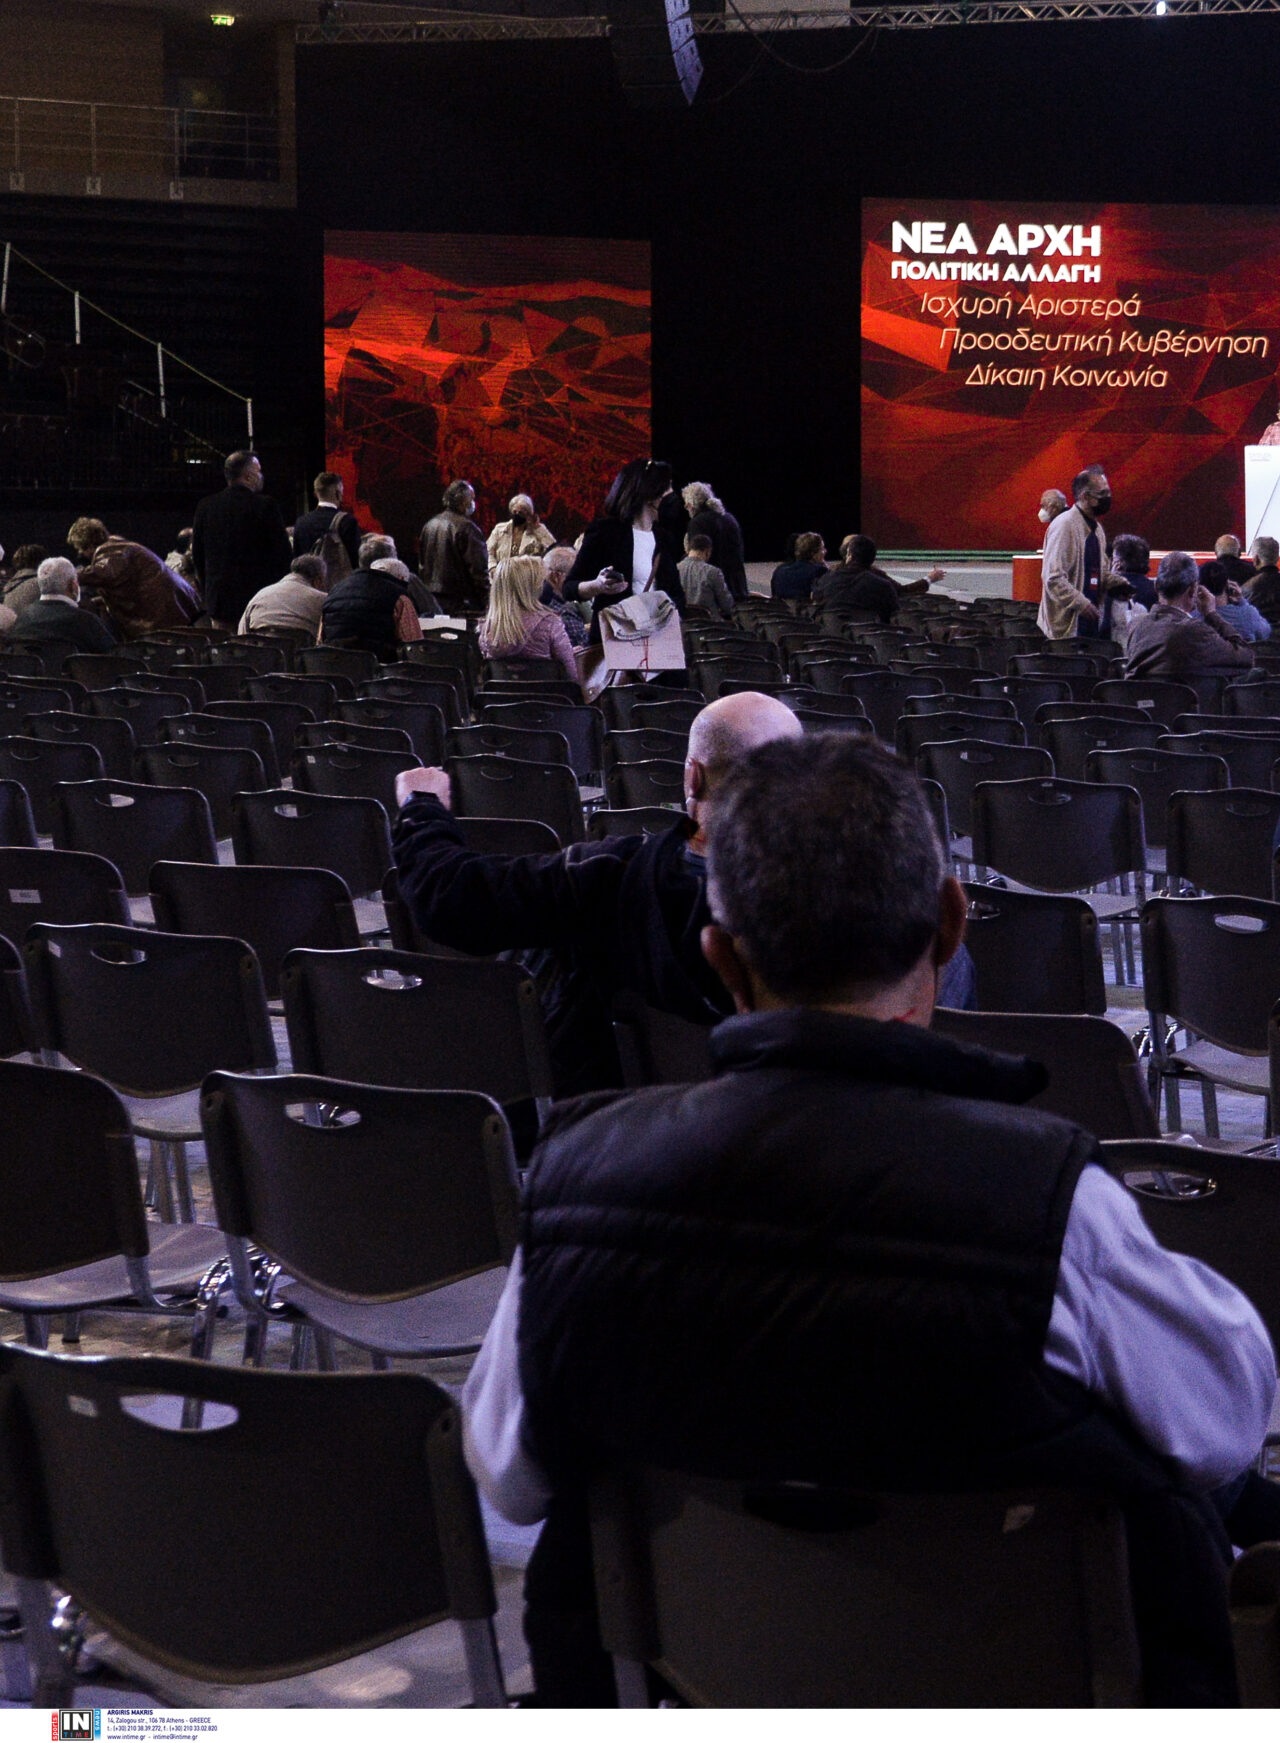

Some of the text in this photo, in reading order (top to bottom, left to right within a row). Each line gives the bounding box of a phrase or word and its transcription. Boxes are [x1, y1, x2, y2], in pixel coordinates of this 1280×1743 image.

[891, 221, 1101, 257] ΝΕΑ ΑΡΧΗ
[891, 261, 1101, 283] ΠΟΛΙΤΙΚΗ ΑΛΛΑΓΗ
[920, 291, 1141, 319] Ισχυρή Αριστερά
[939, 328, 1268, 358] Προοδευτική Κυβέρνηση
[965, 361, 1168, 391] Δίκαιη Κοινωνία
